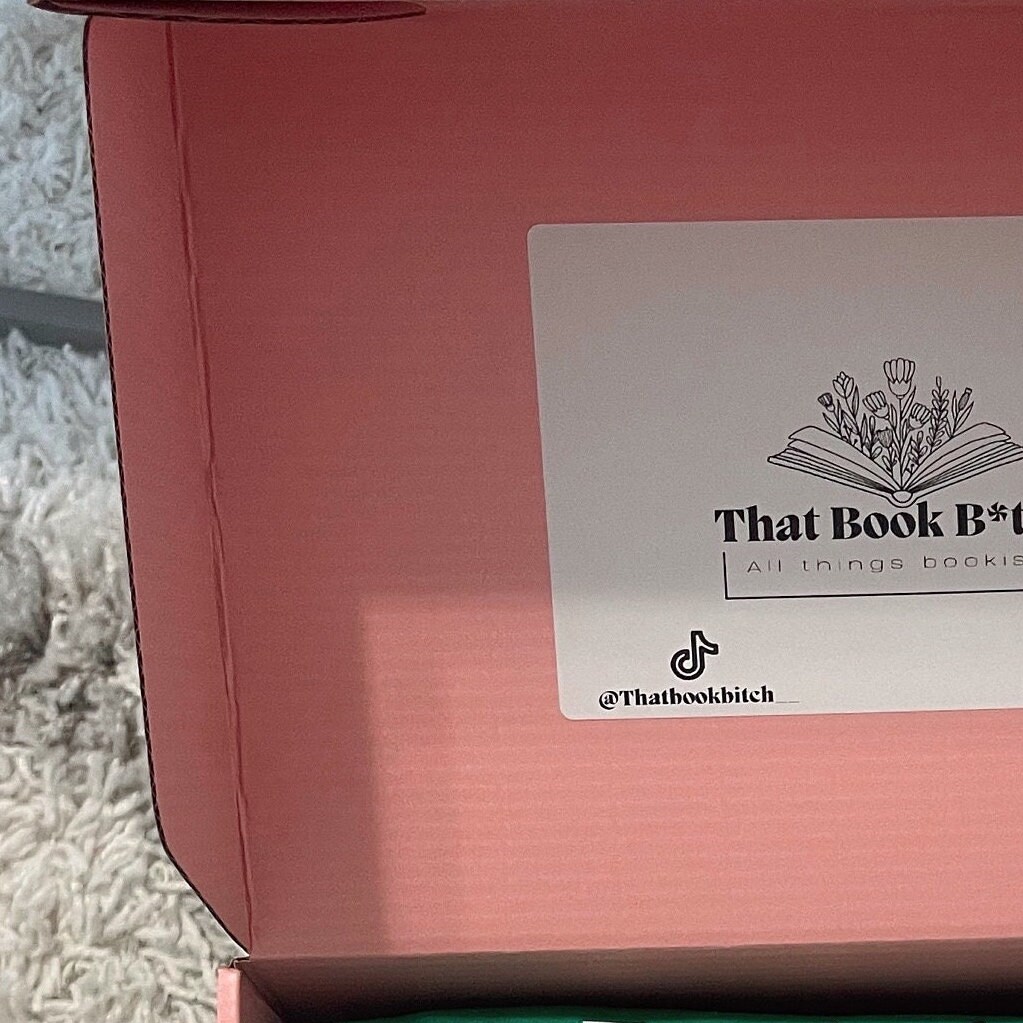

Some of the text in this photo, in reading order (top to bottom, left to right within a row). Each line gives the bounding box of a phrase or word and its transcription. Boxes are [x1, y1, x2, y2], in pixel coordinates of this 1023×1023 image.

[714, 504, 820, 543] That
[830, 500, 945, 540] Book
[746, 559, 783, 574] All
[802, 556, 904, 574] things
